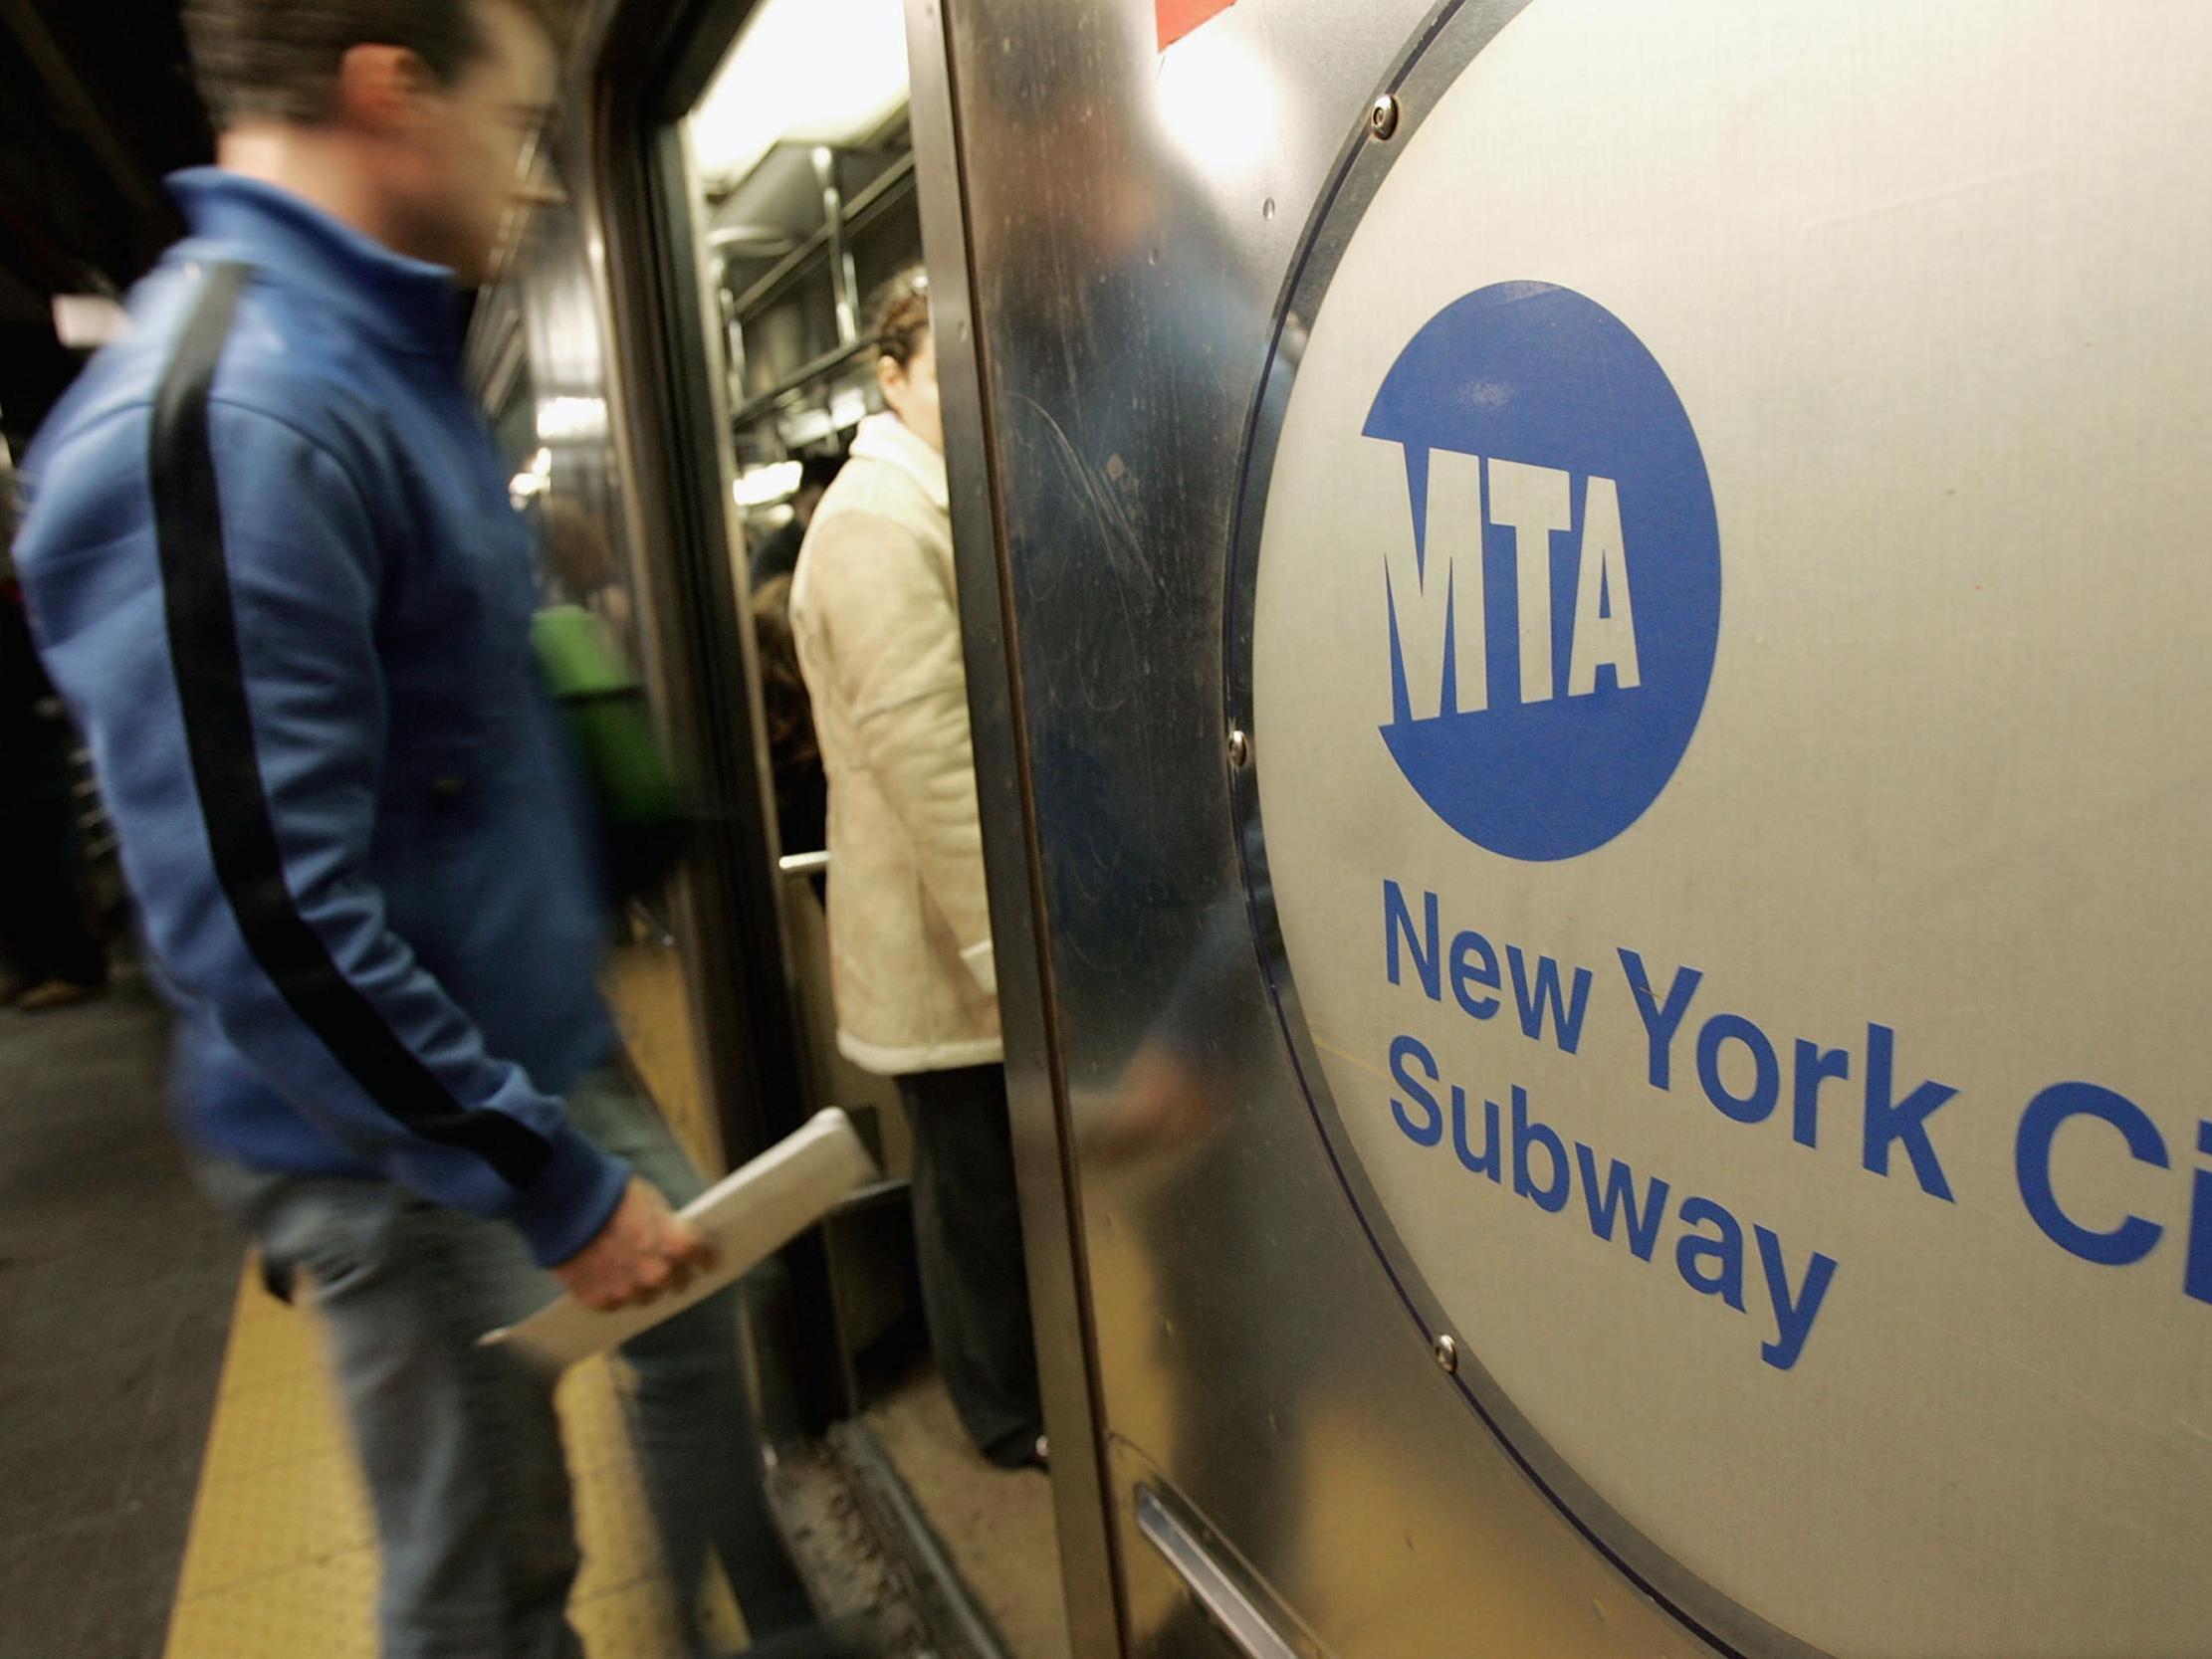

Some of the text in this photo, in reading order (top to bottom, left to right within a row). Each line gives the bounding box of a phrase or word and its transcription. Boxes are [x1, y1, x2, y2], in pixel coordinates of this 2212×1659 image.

[1363, 434, 1642, 724] MTA
[1383, 880, 1593, 1053] New
[1617, 947, 1959, 1201] York
[1389, 1035, 1838, 1370] Subway
